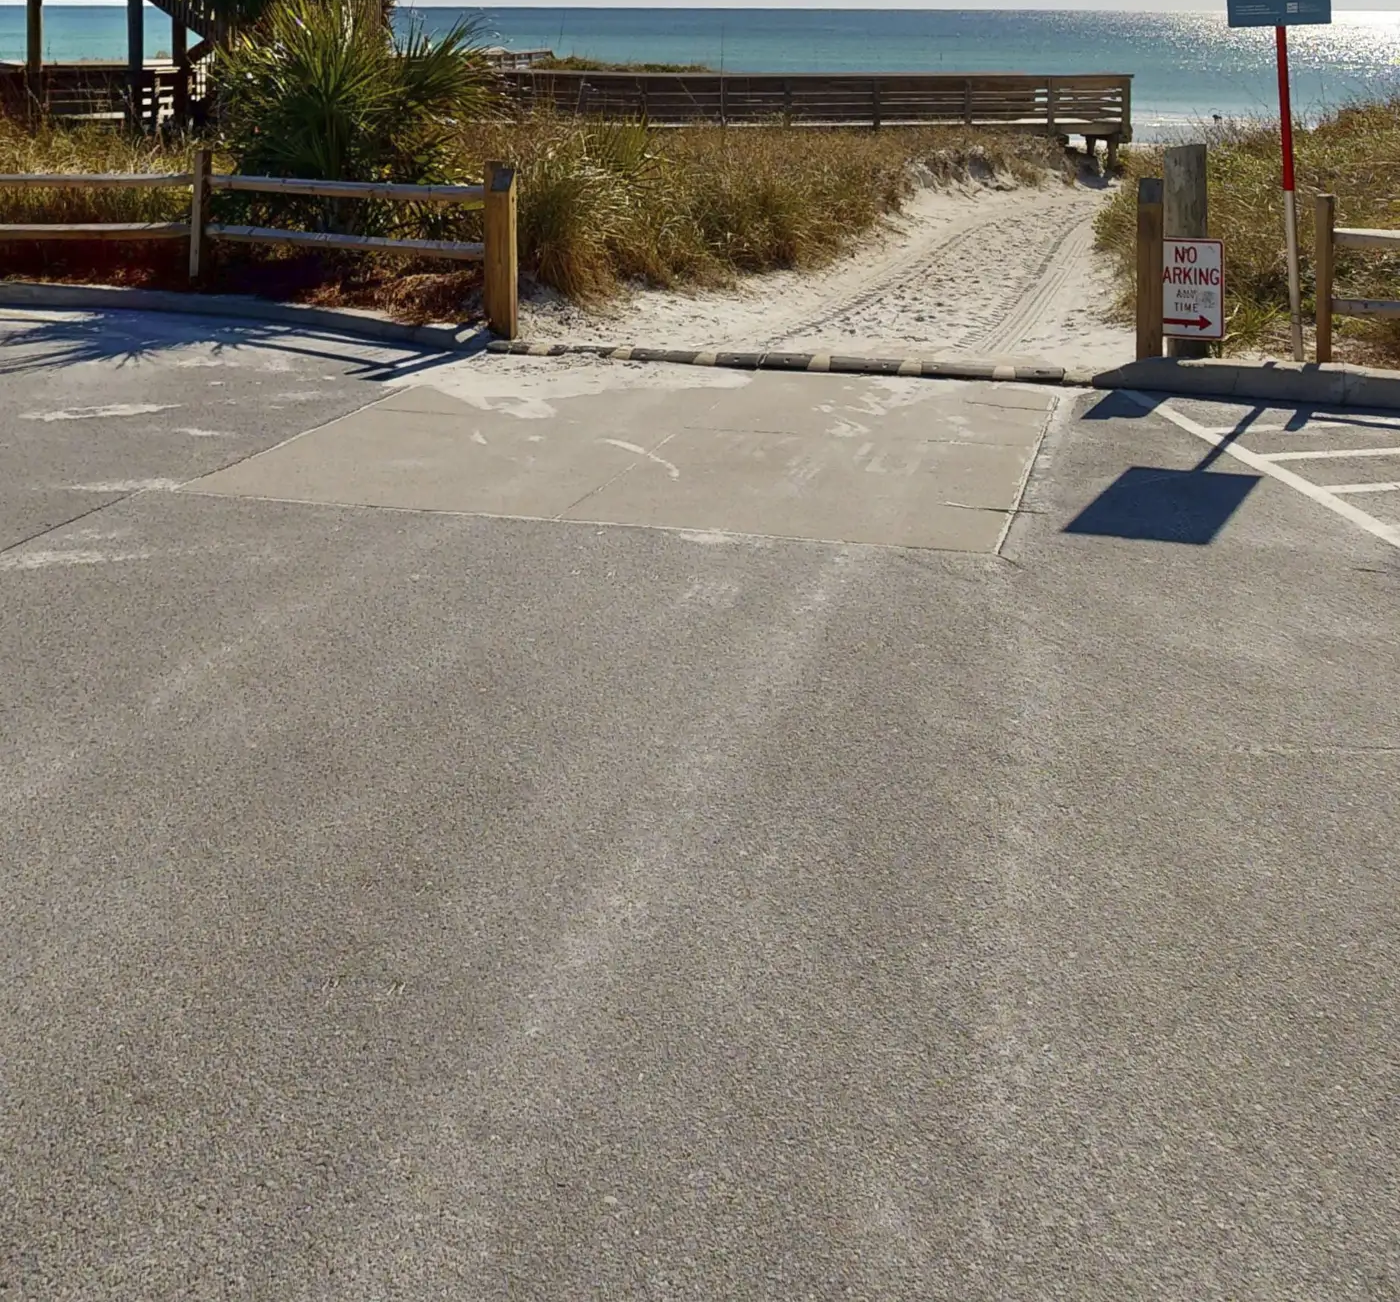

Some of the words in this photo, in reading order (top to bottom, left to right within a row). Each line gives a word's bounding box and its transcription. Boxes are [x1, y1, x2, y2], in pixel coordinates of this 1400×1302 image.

[1174, 246, 1198, 264] NO
[1162, 266, 1220, 286] ARKING
[1174, 302, 1199, 313] TIME
